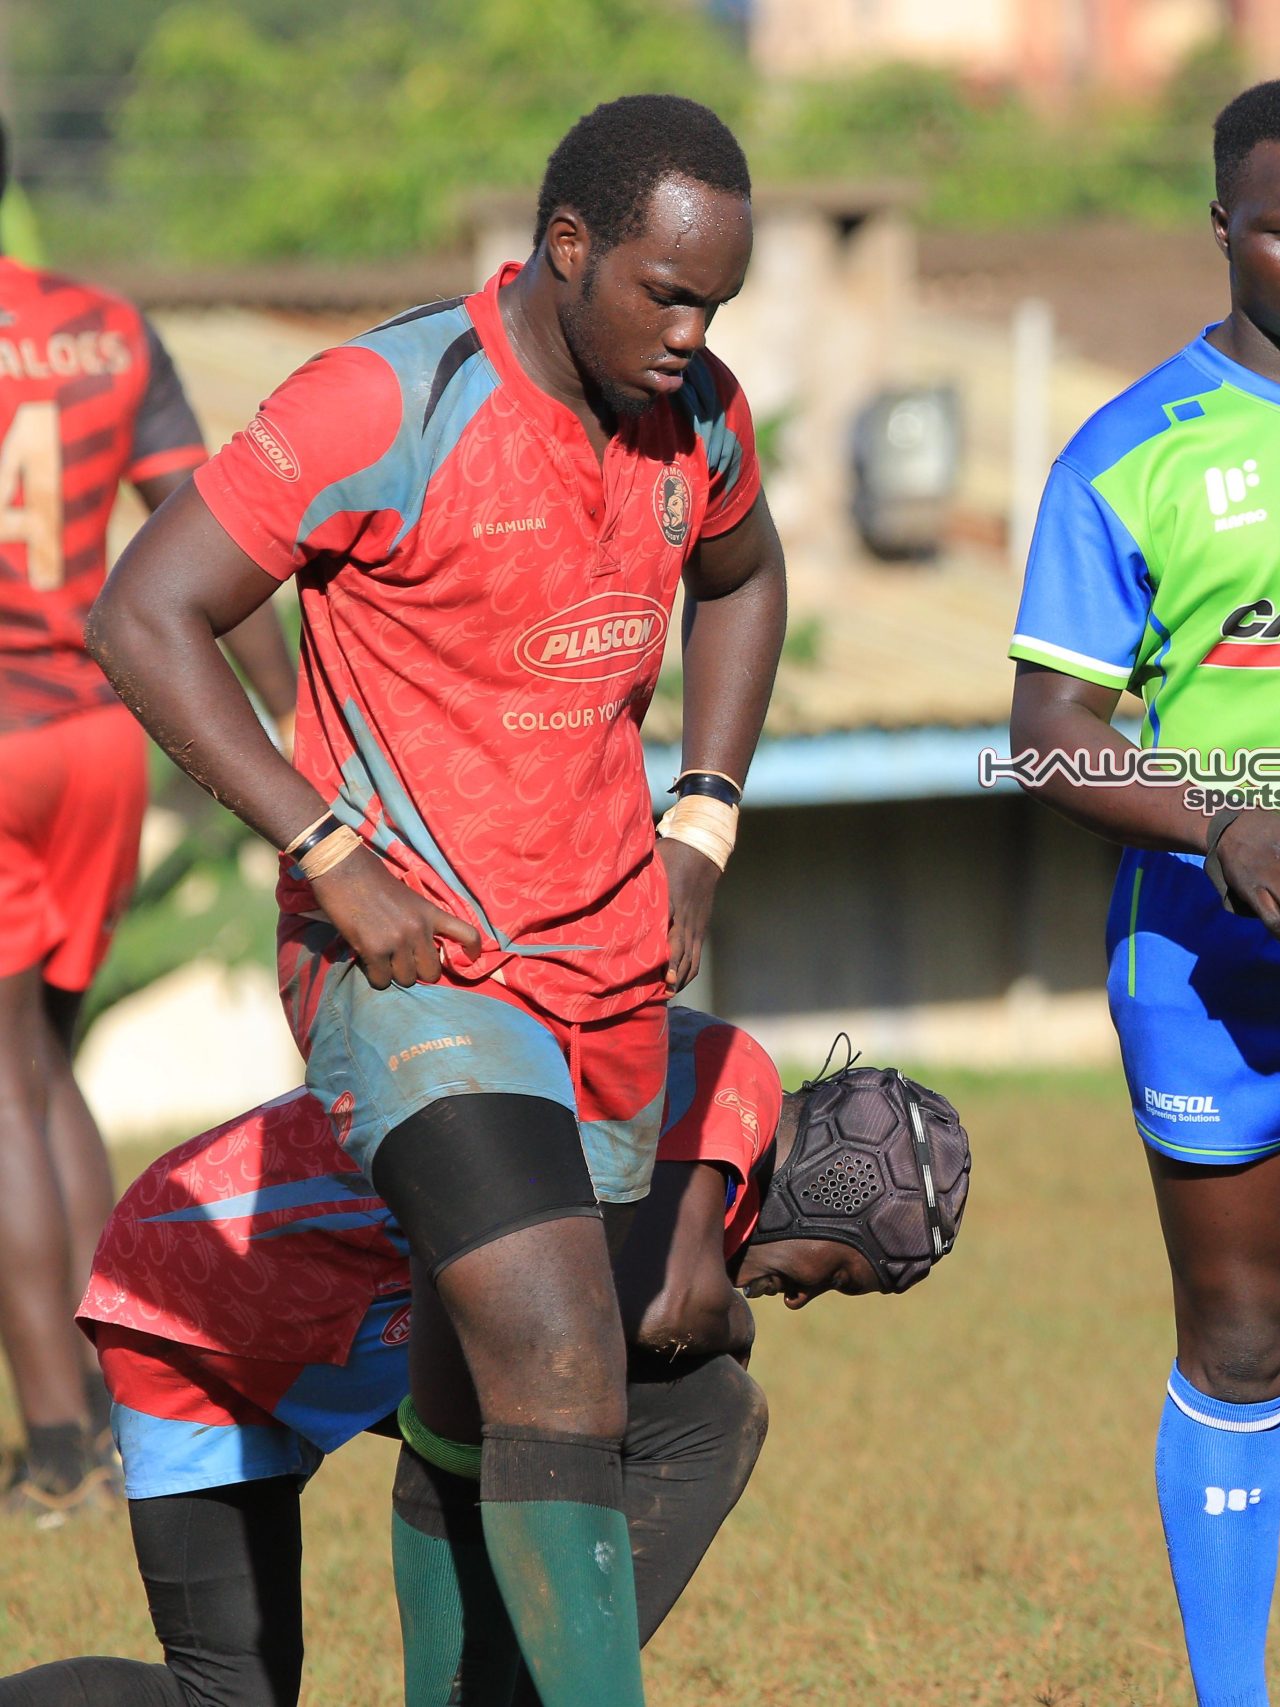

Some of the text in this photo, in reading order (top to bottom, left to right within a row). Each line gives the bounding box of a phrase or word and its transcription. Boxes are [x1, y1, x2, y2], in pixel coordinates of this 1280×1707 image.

[0, 401, 64, 592] 4
[485, 518, 547, 535] SAMURAI
[540, 617, 655, 662] PLASCON
[502, 708, 594, 731] COLOUR
[401, 1035, 472, 1062] SAMURAI
[1144, 1086, 1219, 1113] ENGSOL
[1145, 1103, 1221, 1123] Engineering Solutions
